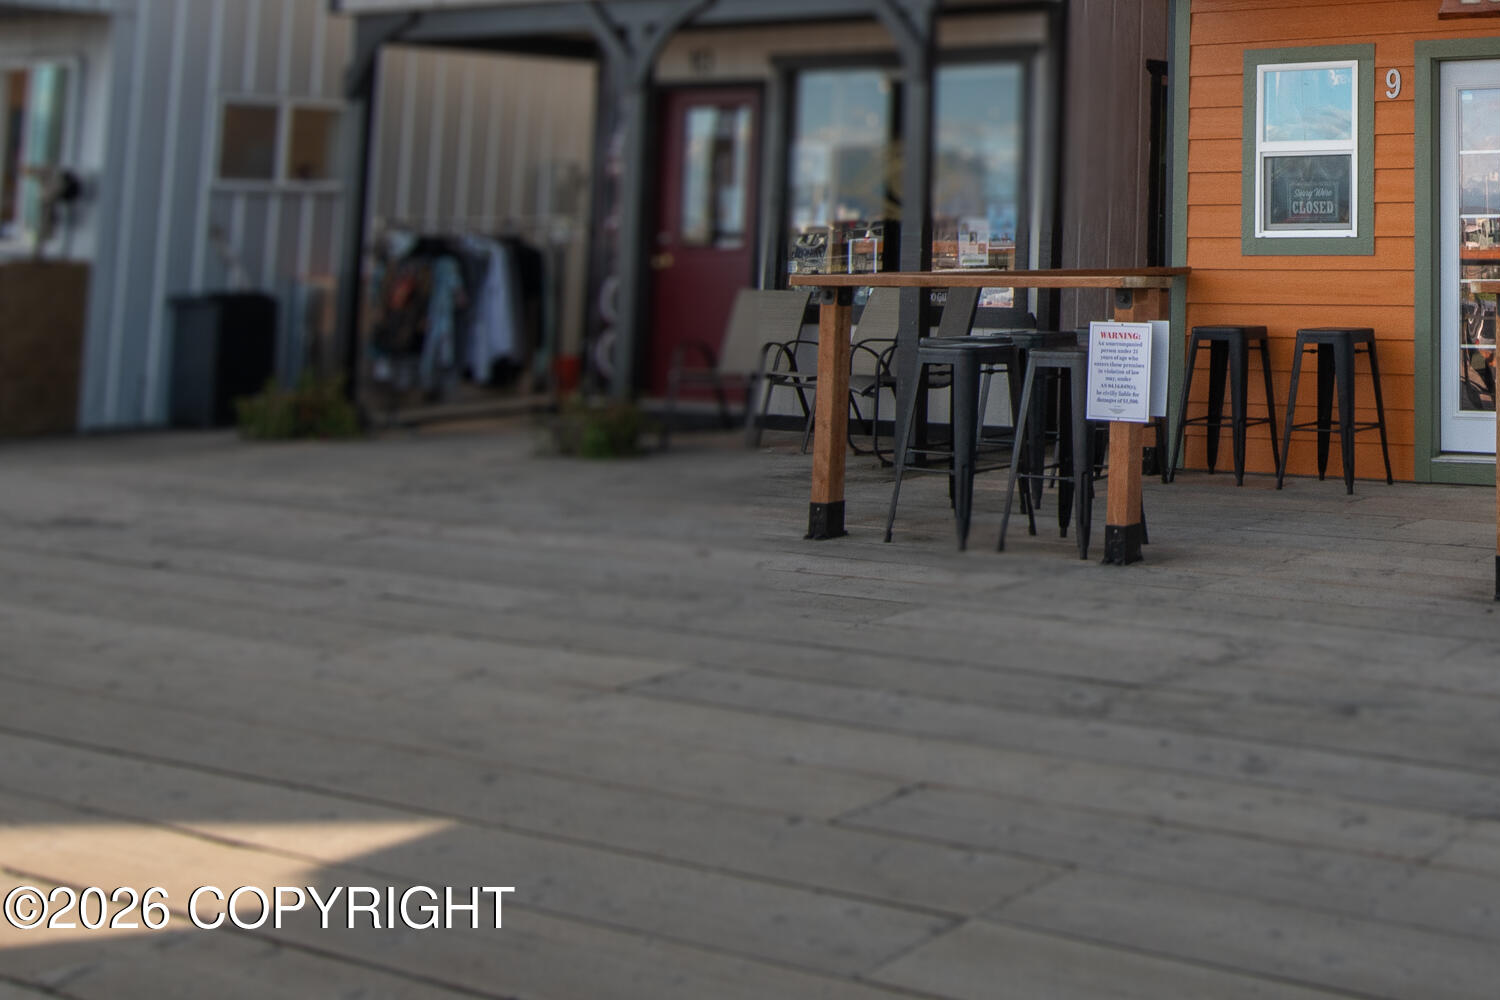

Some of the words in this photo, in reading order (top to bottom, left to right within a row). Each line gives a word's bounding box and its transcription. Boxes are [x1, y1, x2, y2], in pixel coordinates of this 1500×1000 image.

[1385, 68, 1401, 99] 9
[1292, 200, 1334, 214] CLOSED
[1100, 331, 1141, 340] WARNING:
